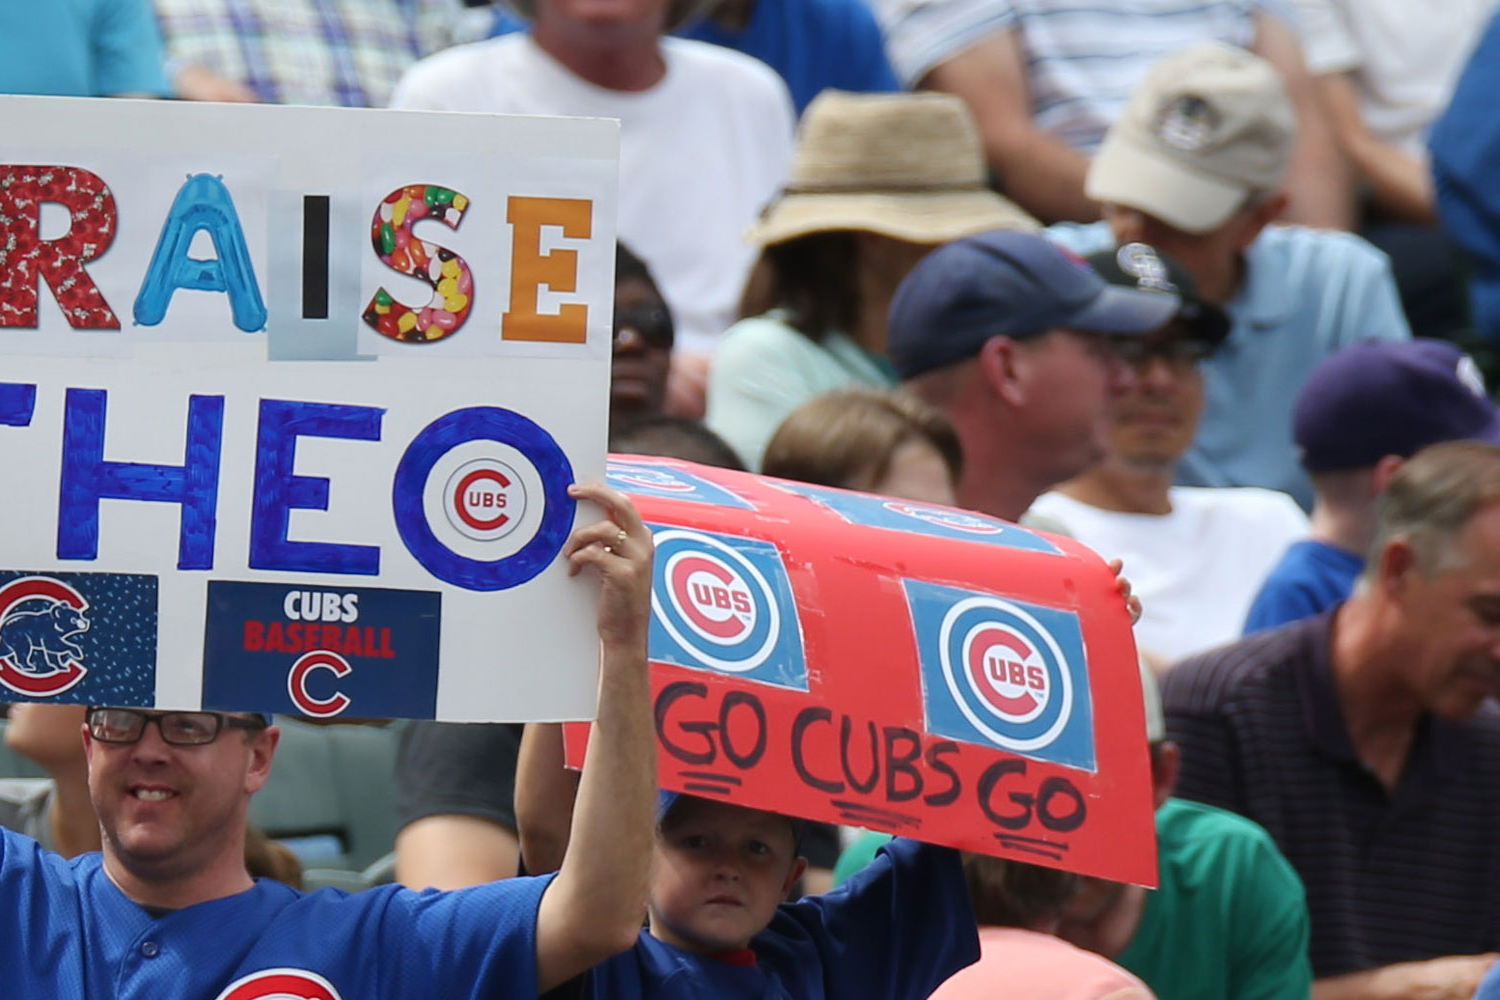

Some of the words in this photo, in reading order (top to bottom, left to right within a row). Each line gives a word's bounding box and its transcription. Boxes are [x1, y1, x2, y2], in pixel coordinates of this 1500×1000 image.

[283, 590, 359, 624] CUBS
[242, 619, 396, 659] BASEBALL
[287, 649, 353, 718] C
[654, 681, 767, 770] GO
[790, 706, 962, 807] CUBS
[977, 759, 1087, 833] GO
